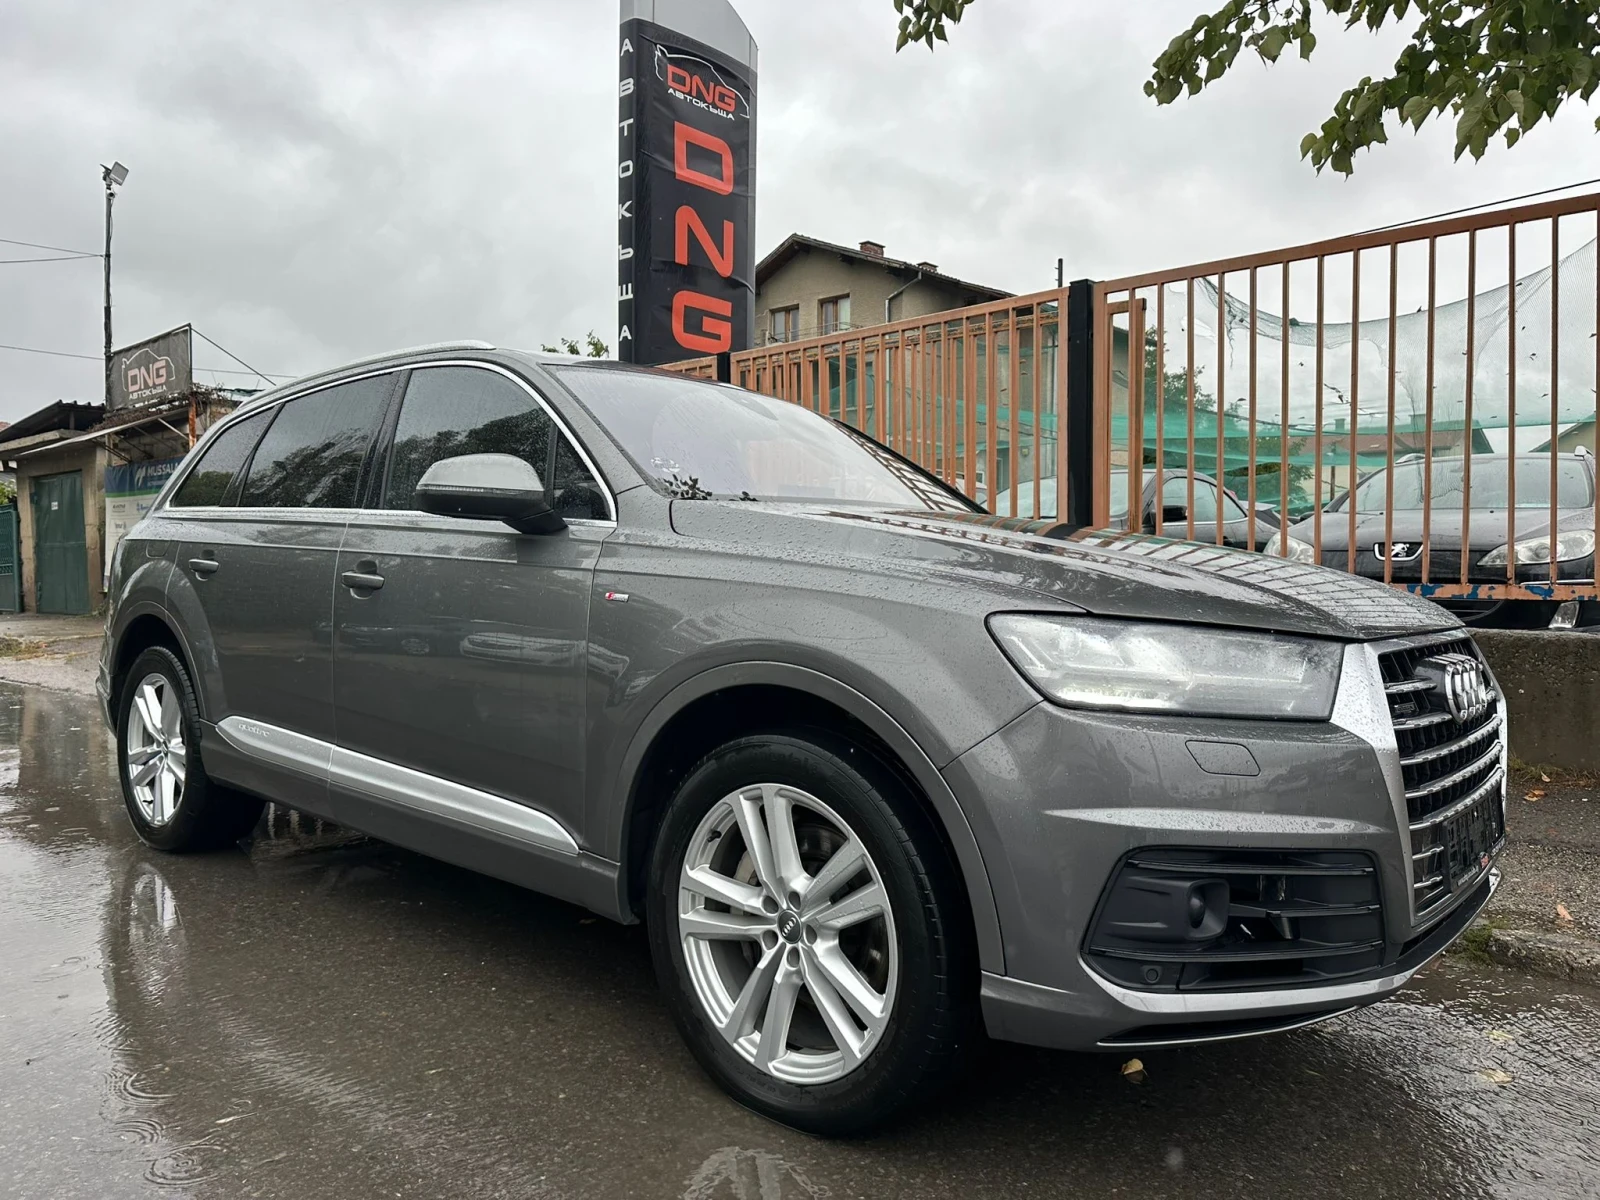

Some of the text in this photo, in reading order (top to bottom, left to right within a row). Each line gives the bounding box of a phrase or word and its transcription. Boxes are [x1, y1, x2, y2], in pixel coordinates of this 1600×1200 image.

[667, 63, 736, 112] DNG
[672, 121, 734, 354] DNG
[128, 360, 166, 393] DNG
[239, 724, 269, 737] quattro
